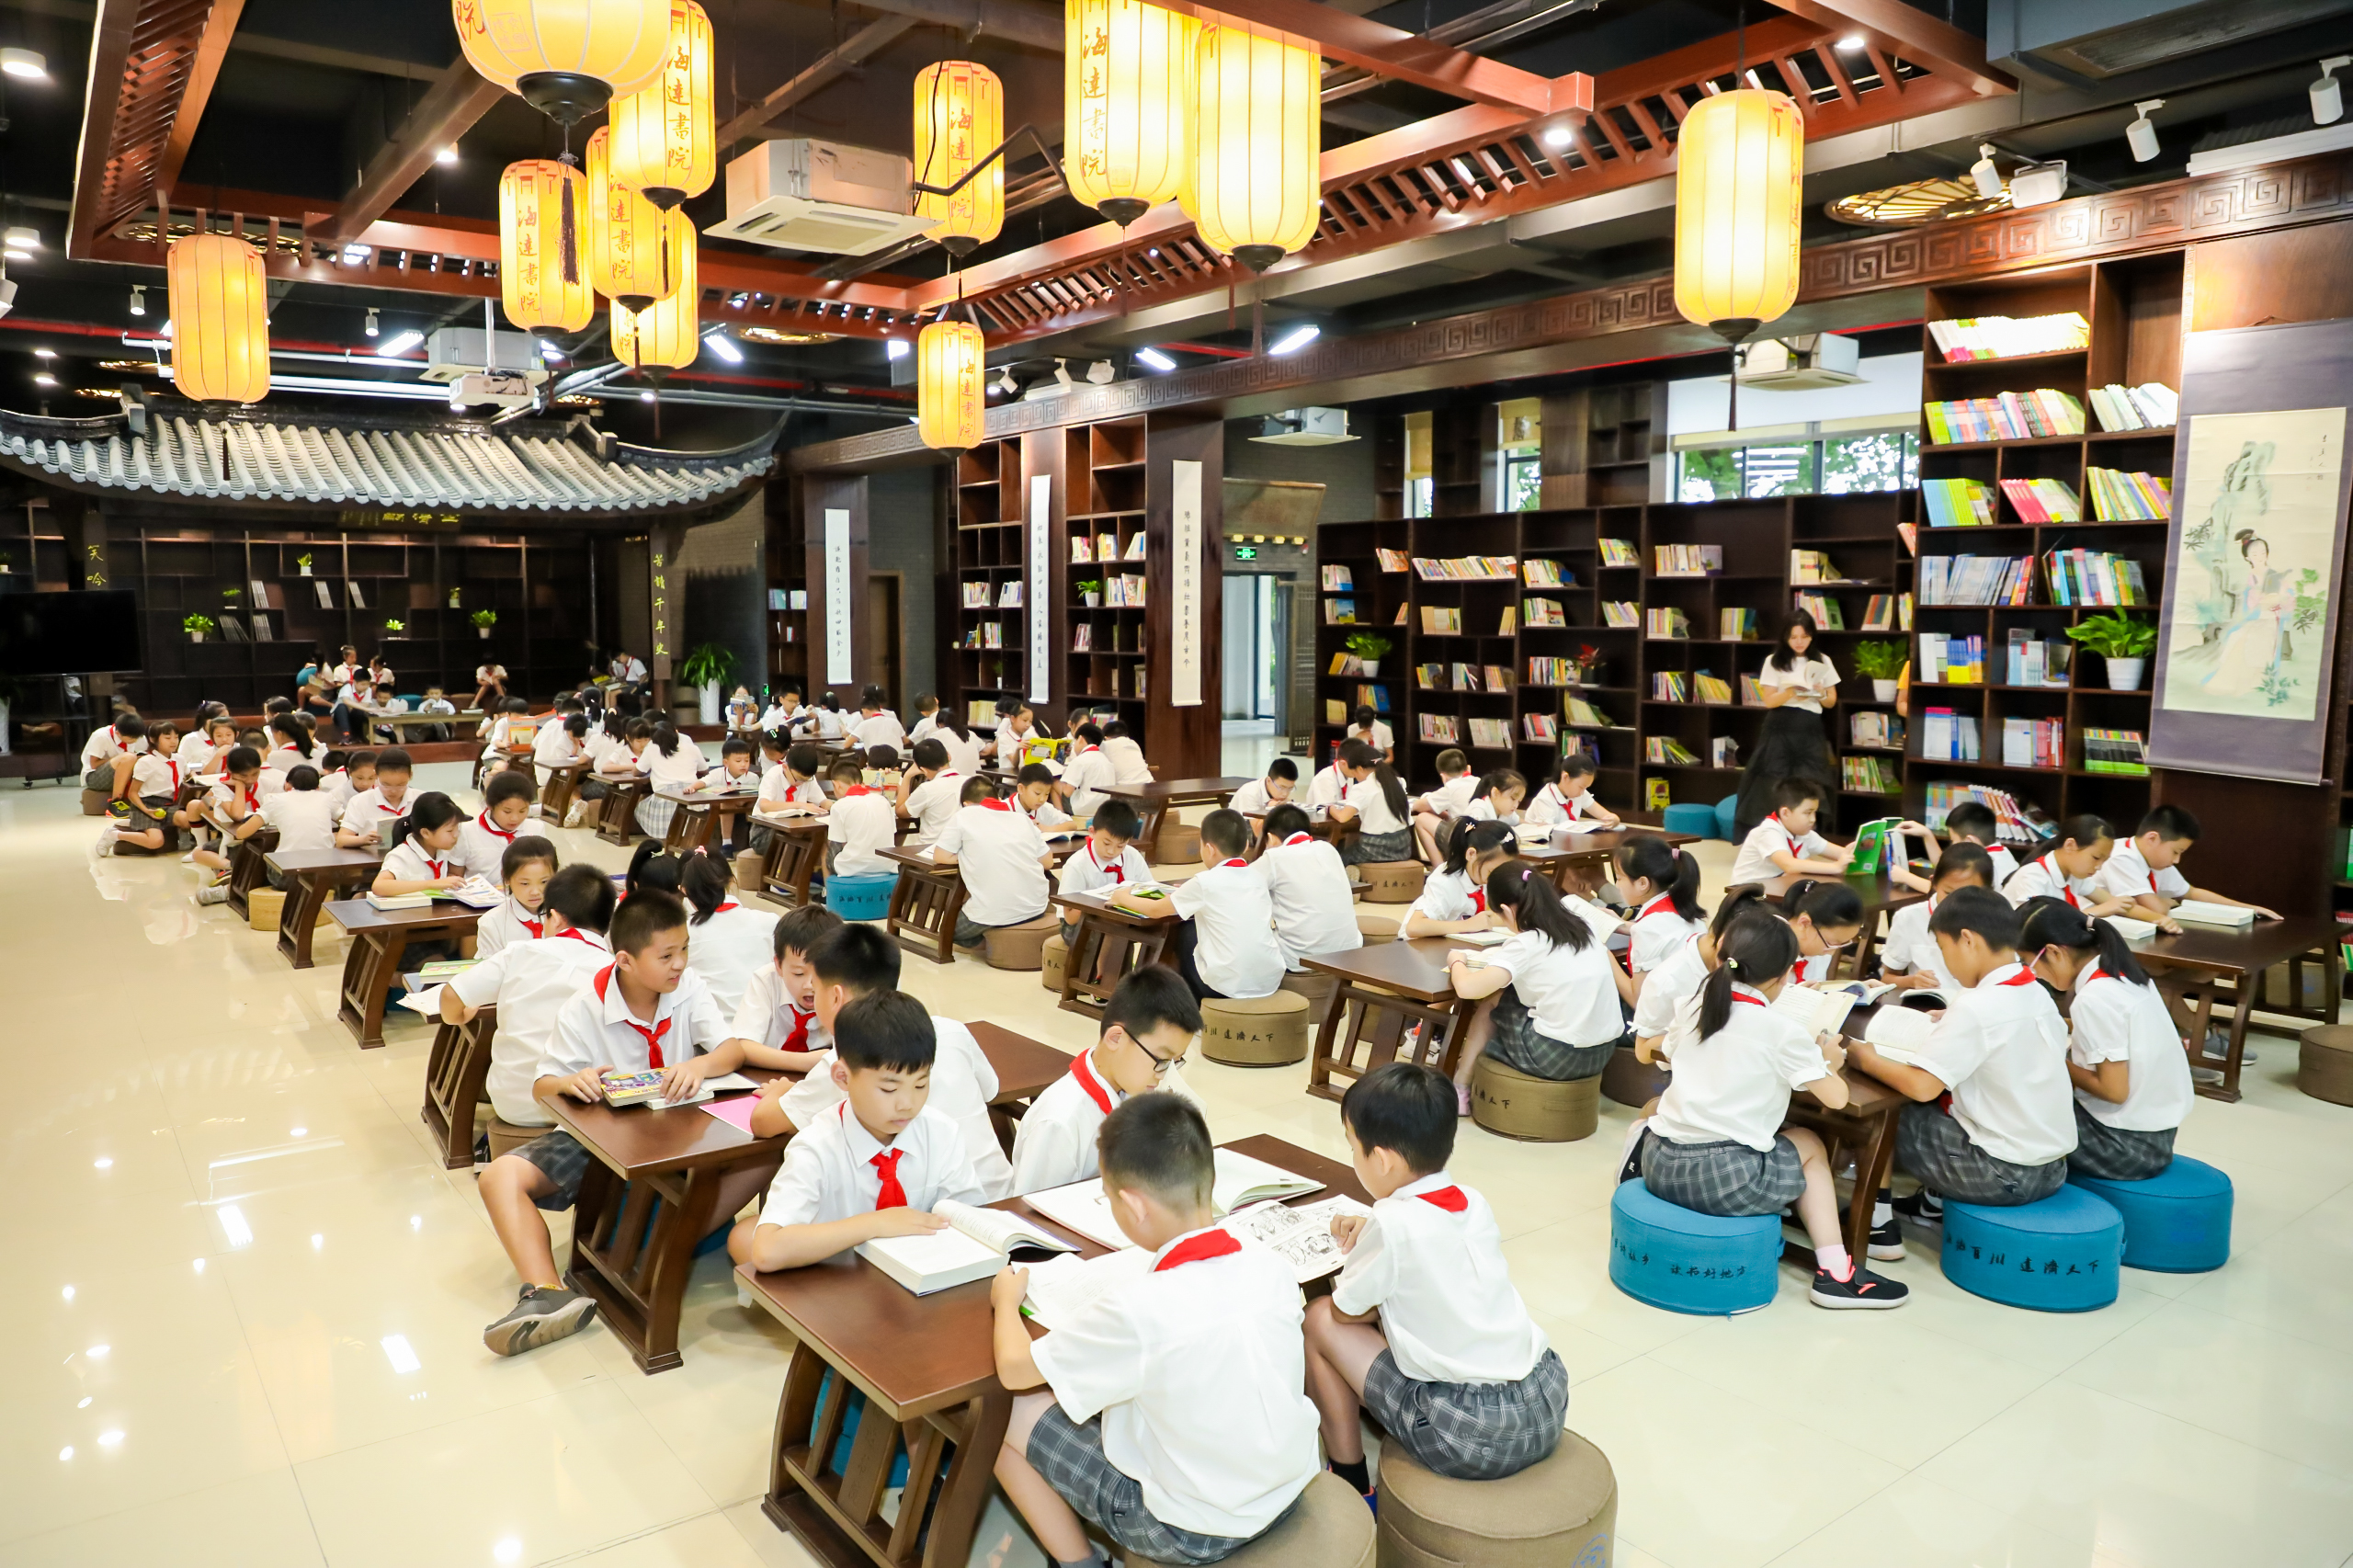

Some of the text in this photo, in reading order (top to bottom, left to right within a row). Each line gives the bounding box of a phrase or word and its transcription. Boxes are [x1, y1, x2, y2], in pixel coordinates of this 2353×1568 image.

[666, 46, 691, 171] 海達書院
[1082, 27, 1108, 178] 海達書院
[517, 205, 541, 312] 海達書院
[960, 358, 975, 437] 海達書院
